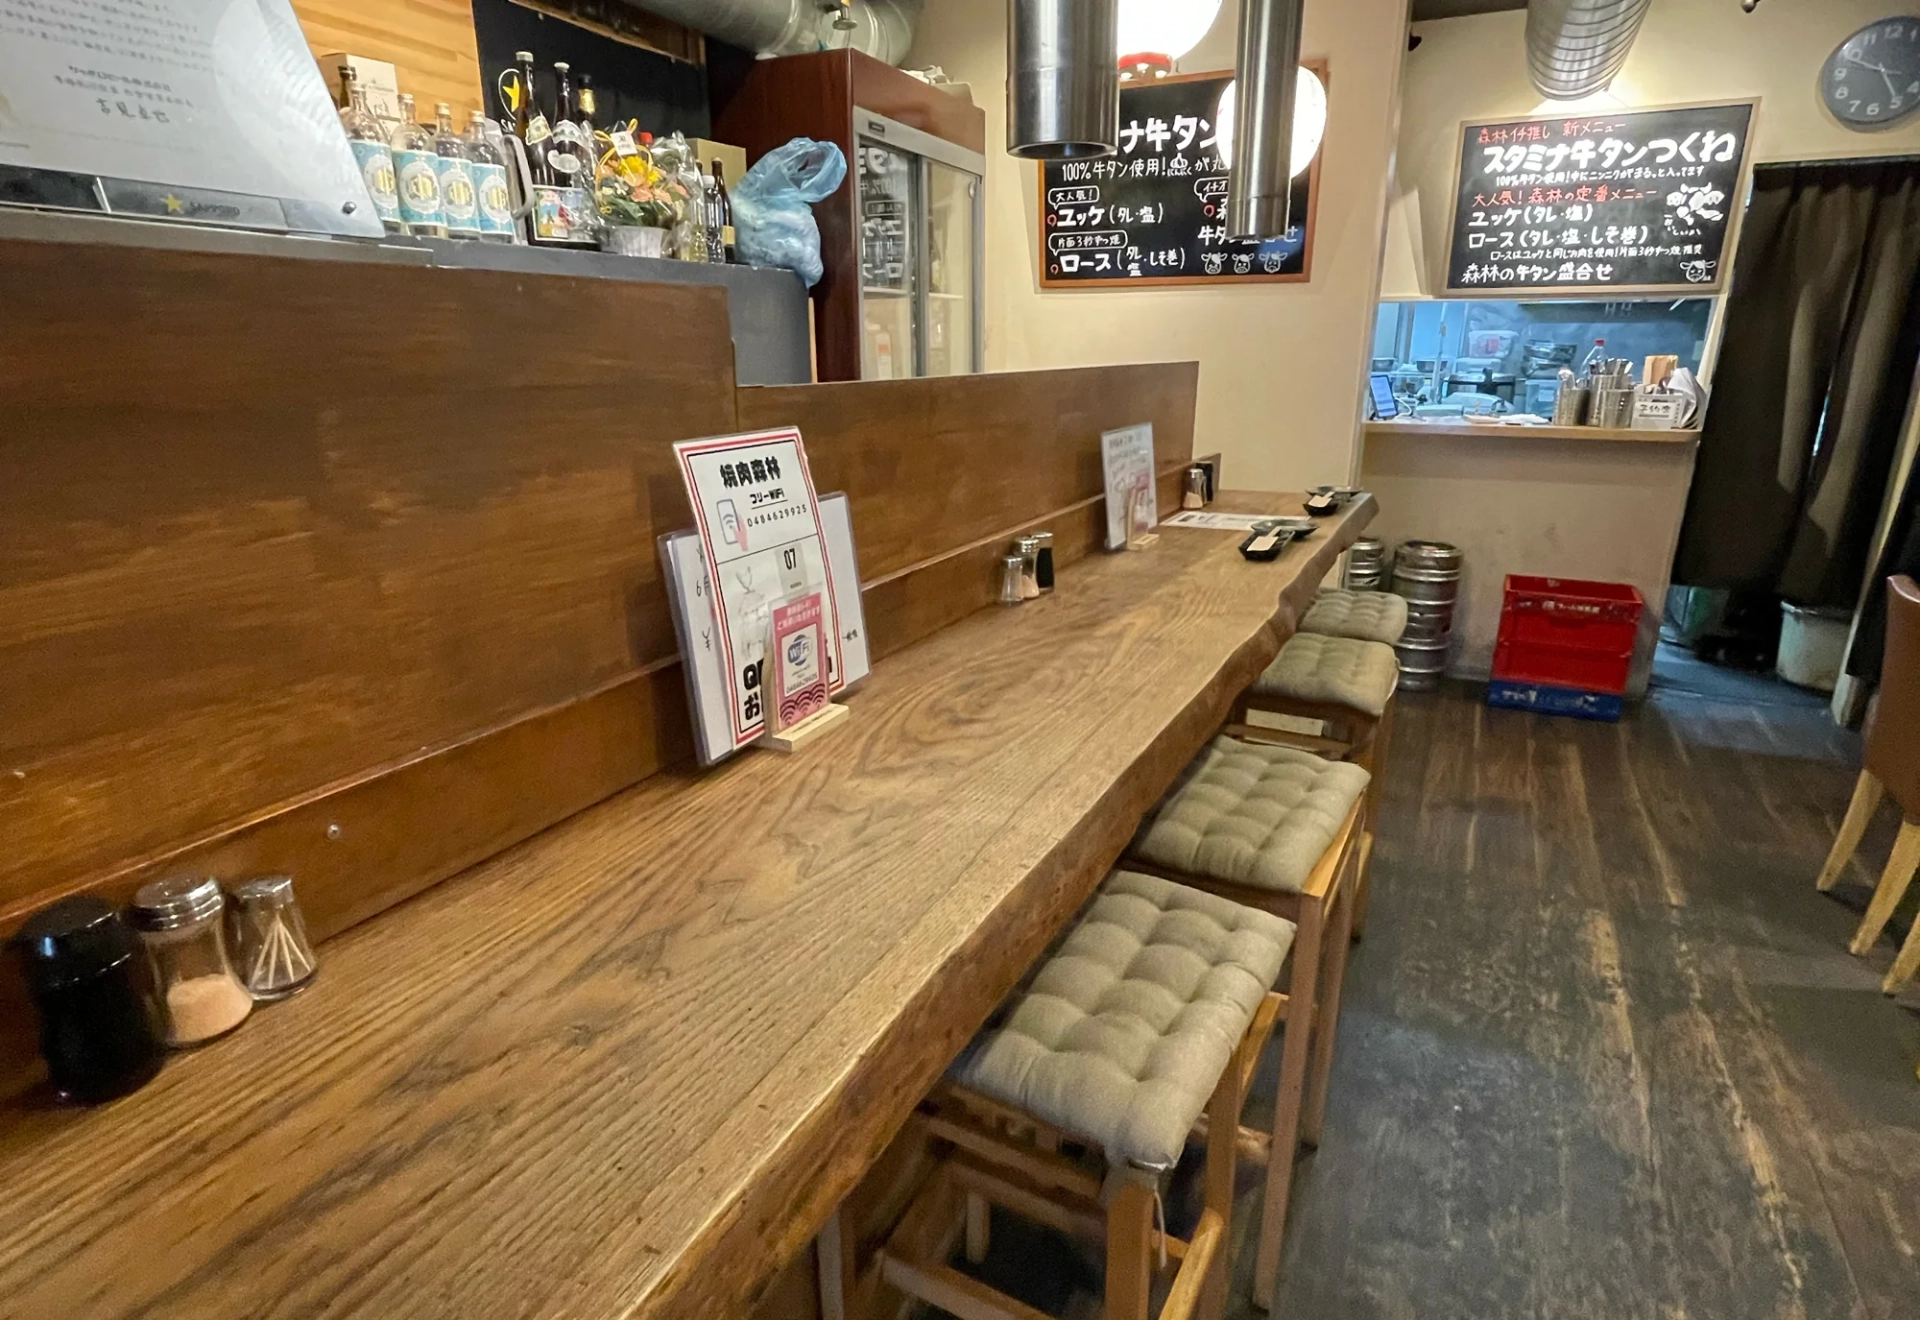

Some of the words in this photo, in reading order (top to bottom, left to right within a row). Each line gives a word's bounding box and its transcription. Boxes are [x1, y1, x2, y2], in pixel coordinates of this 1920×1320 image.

[1834, 68, 1847, 80] 9
[1835, 87, 1849, 99] 8
[1849, 100, 1861, 112] 7
[1866, 103, 1880, 115] 6
[1890, 96, 1902, 109] 5
[500, 119, 516, 133] SA
[1478, 125, 1551, 144] 森林イチ推し
[1563, 120, 1627, 138] 新メニュー
[1483, 130, 1736, 175] スタミナ牛タンつくね
[1461, 261, 1613, 283] 森林の牛タン盛合せ
[720, 456, 781, 489] 焼肉森林
[747, 504, 808, 527] 0484629925
[783, 548, 797, 571] 07
